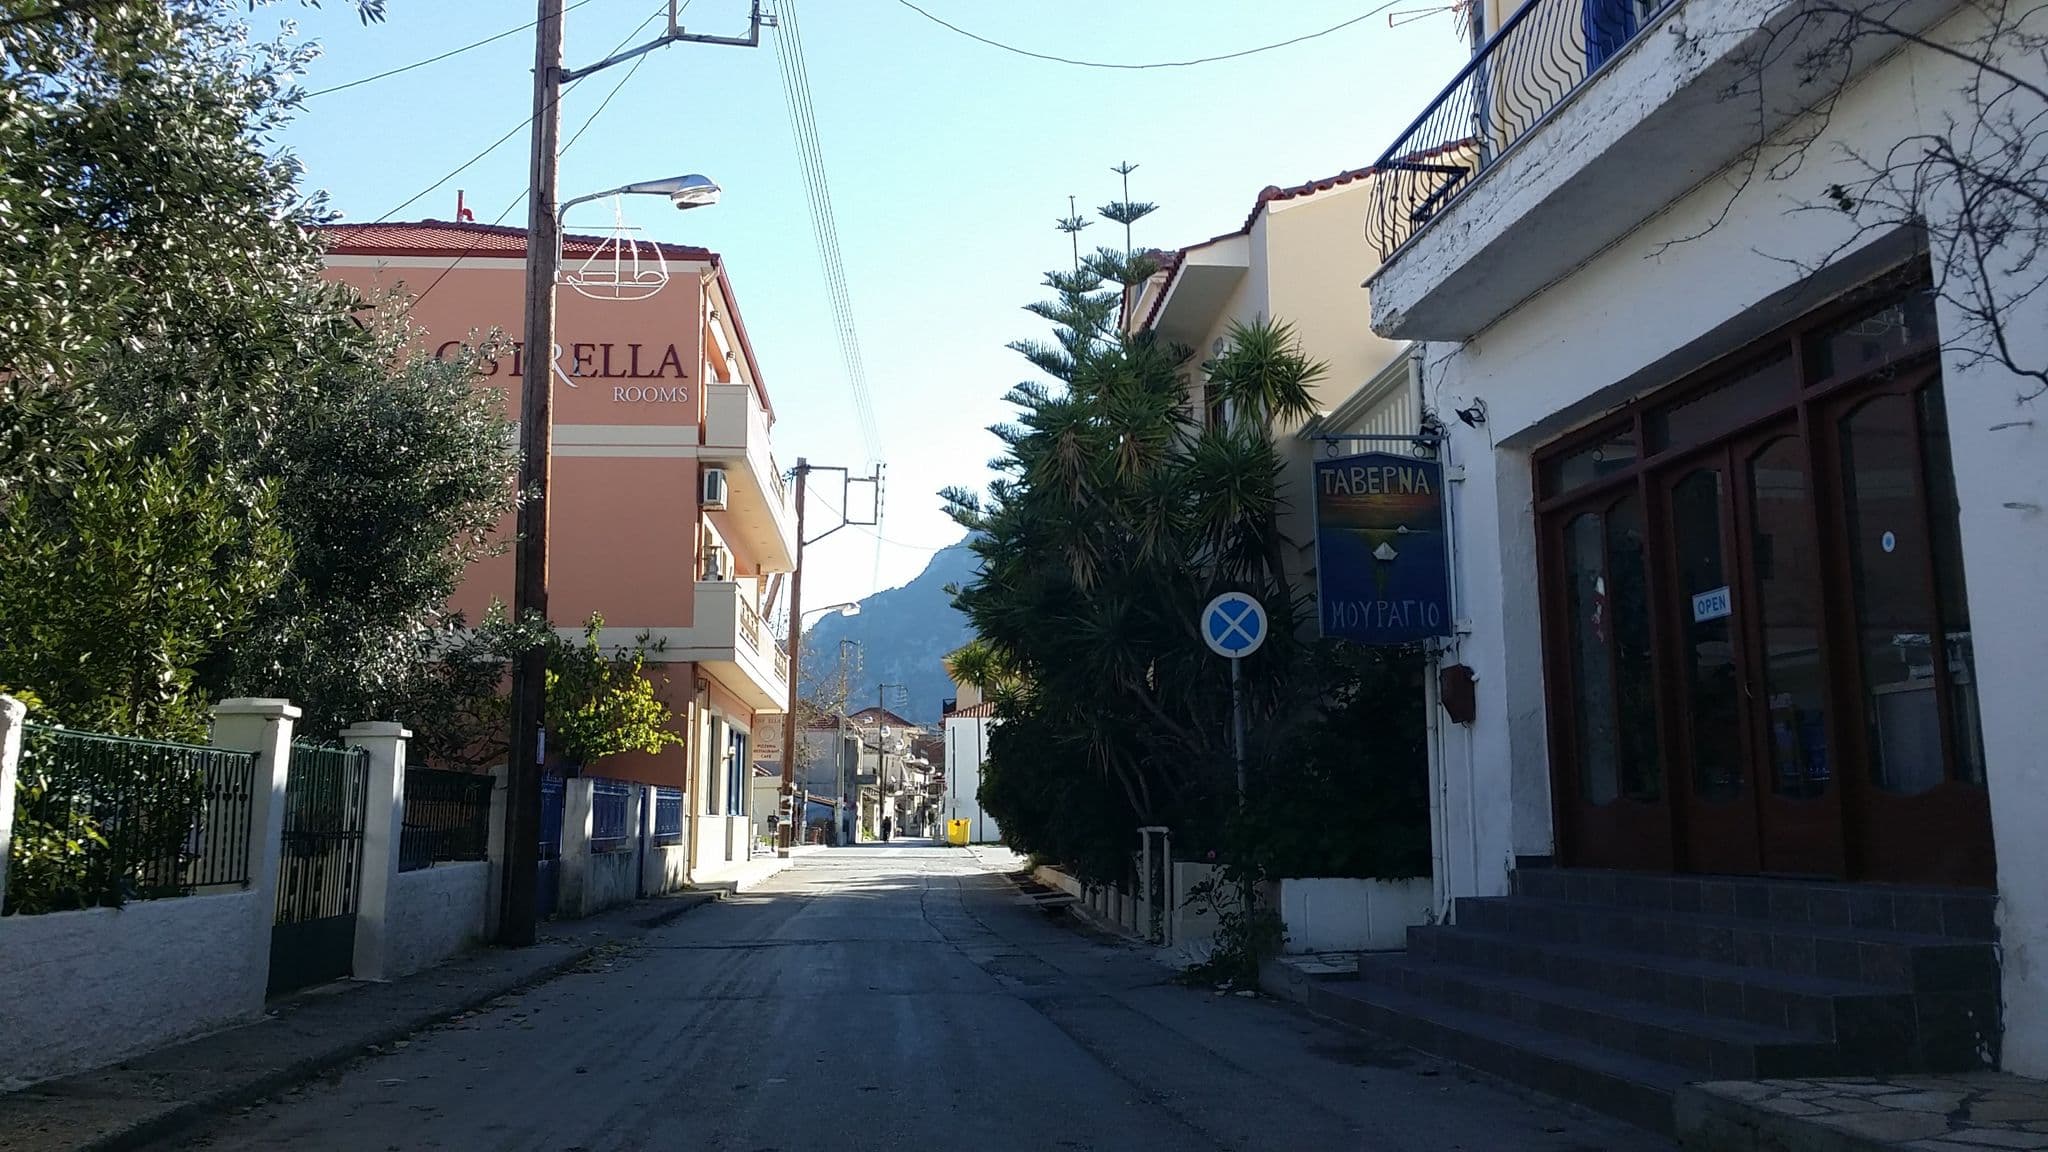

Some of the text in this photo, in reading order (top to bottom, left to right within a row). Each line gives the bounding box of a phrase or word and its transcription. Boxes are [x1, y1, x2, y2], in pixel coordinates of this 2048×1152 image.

[613, 386, 688, 402] ROOMS
[1321, 467, 1430, 495] ΤΑΒΕΡΝΑ
[1332, 600, 1440, 630] ΜΟΥΡΑΓΙΟ
[1698, 594, 1726, 615] OPEN
